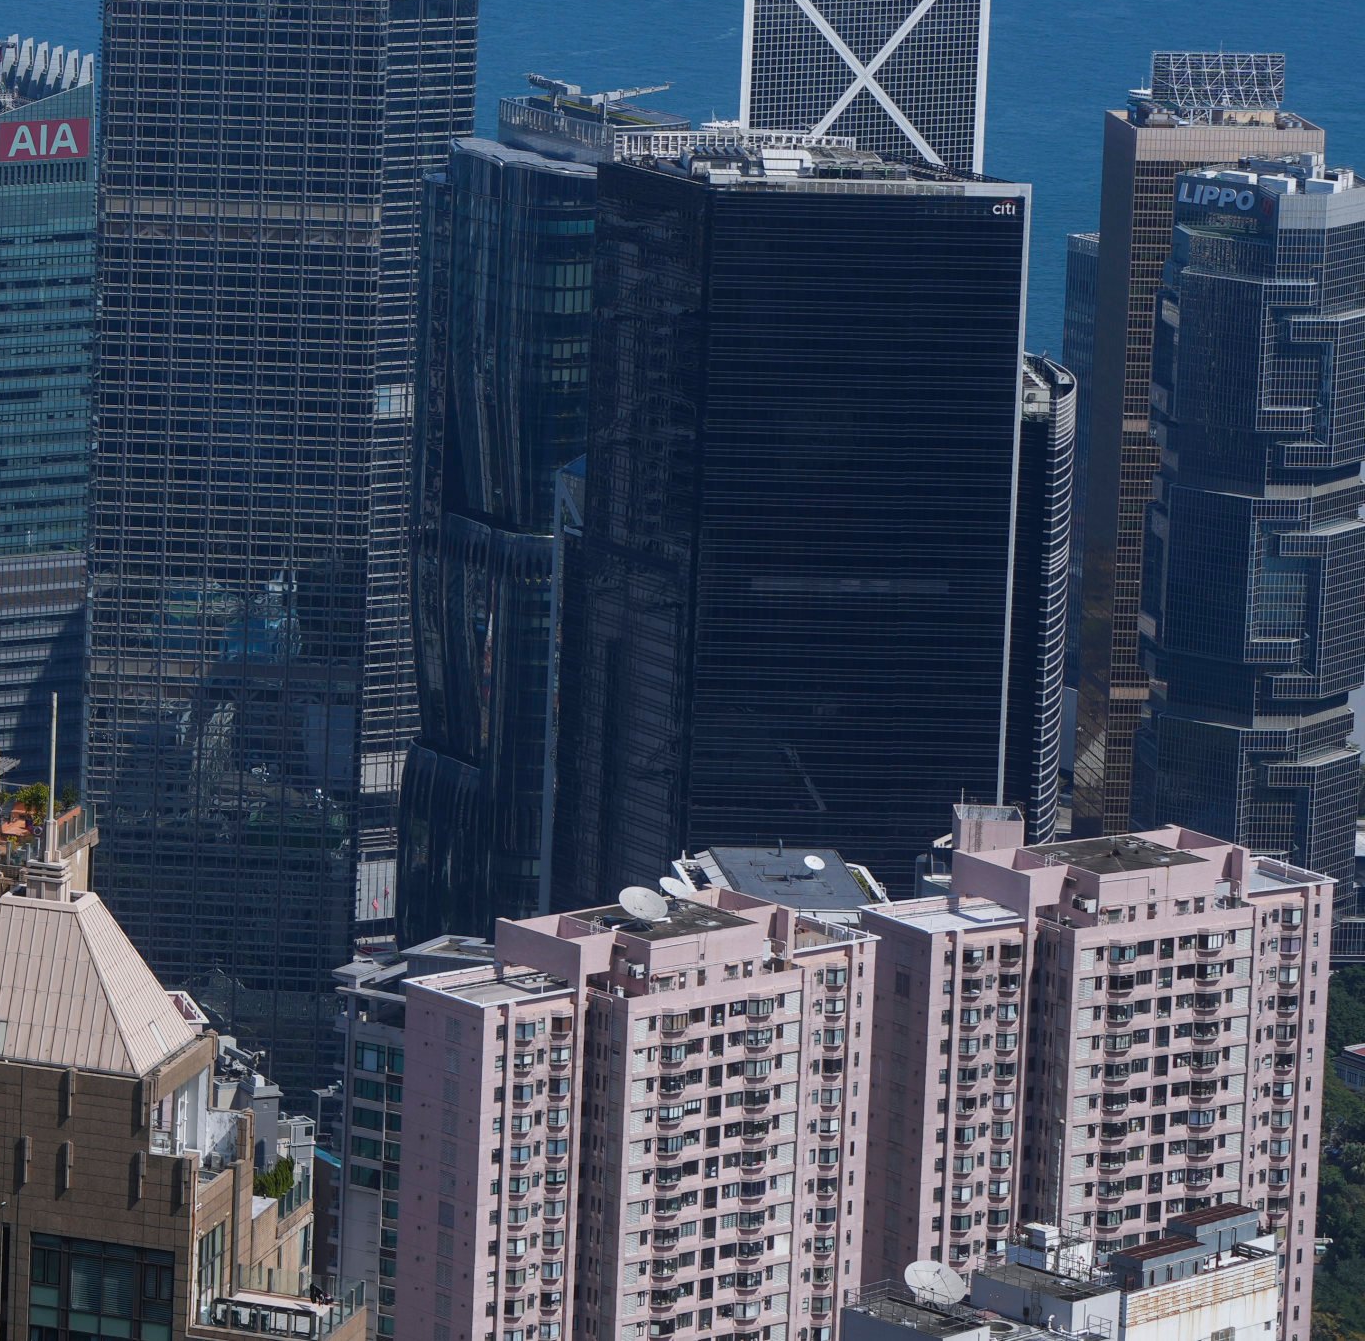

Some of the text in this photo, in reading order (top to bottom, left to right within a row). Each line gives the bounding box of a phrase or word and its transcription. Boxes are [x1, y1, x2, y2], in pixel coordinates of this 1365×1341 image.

[7, 122, 78, 157] AIA
[992, 202, 1016, 216] citi
[1177, 182, 1255, 211] LIPPO
